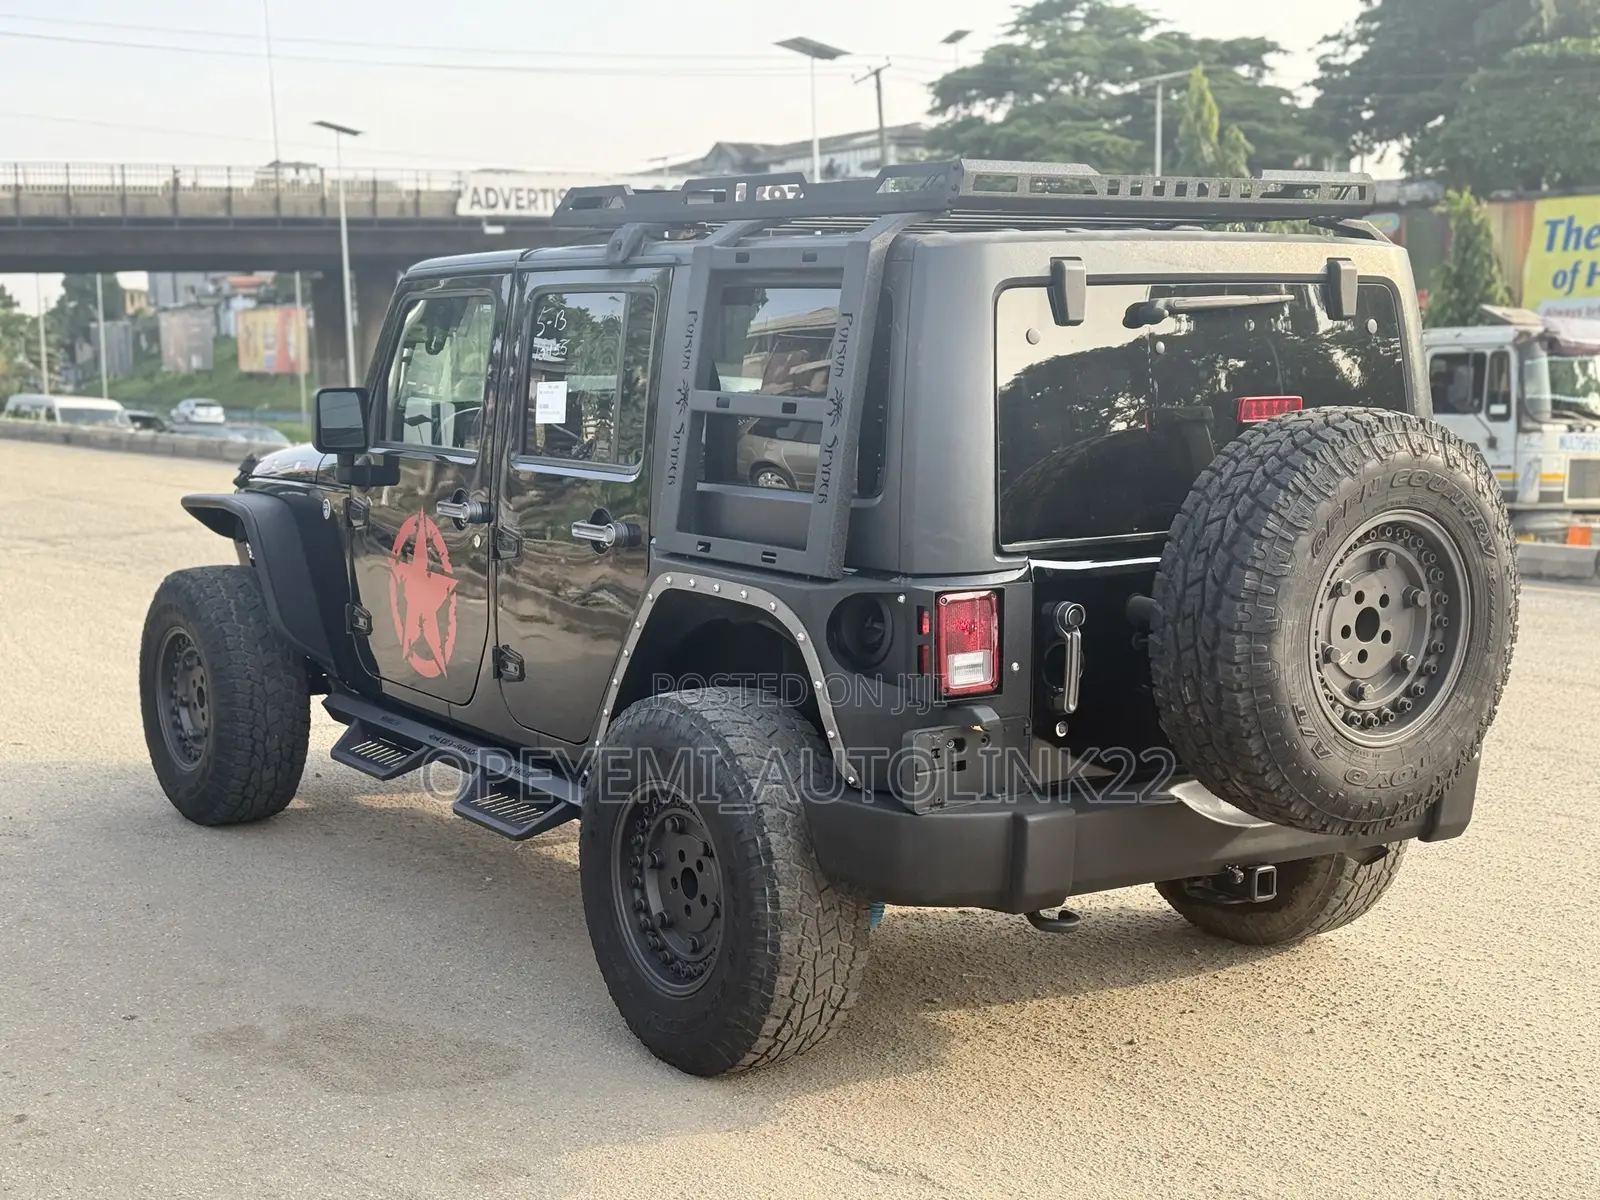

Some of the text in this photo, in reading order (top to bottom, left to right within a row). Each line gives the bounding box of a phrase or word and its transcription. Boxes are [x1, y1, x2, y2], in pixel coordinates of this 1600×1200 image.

[1552, 259, 1582, 297] of
[1312, 468, 1498, 560] OPEN COUNTRY
